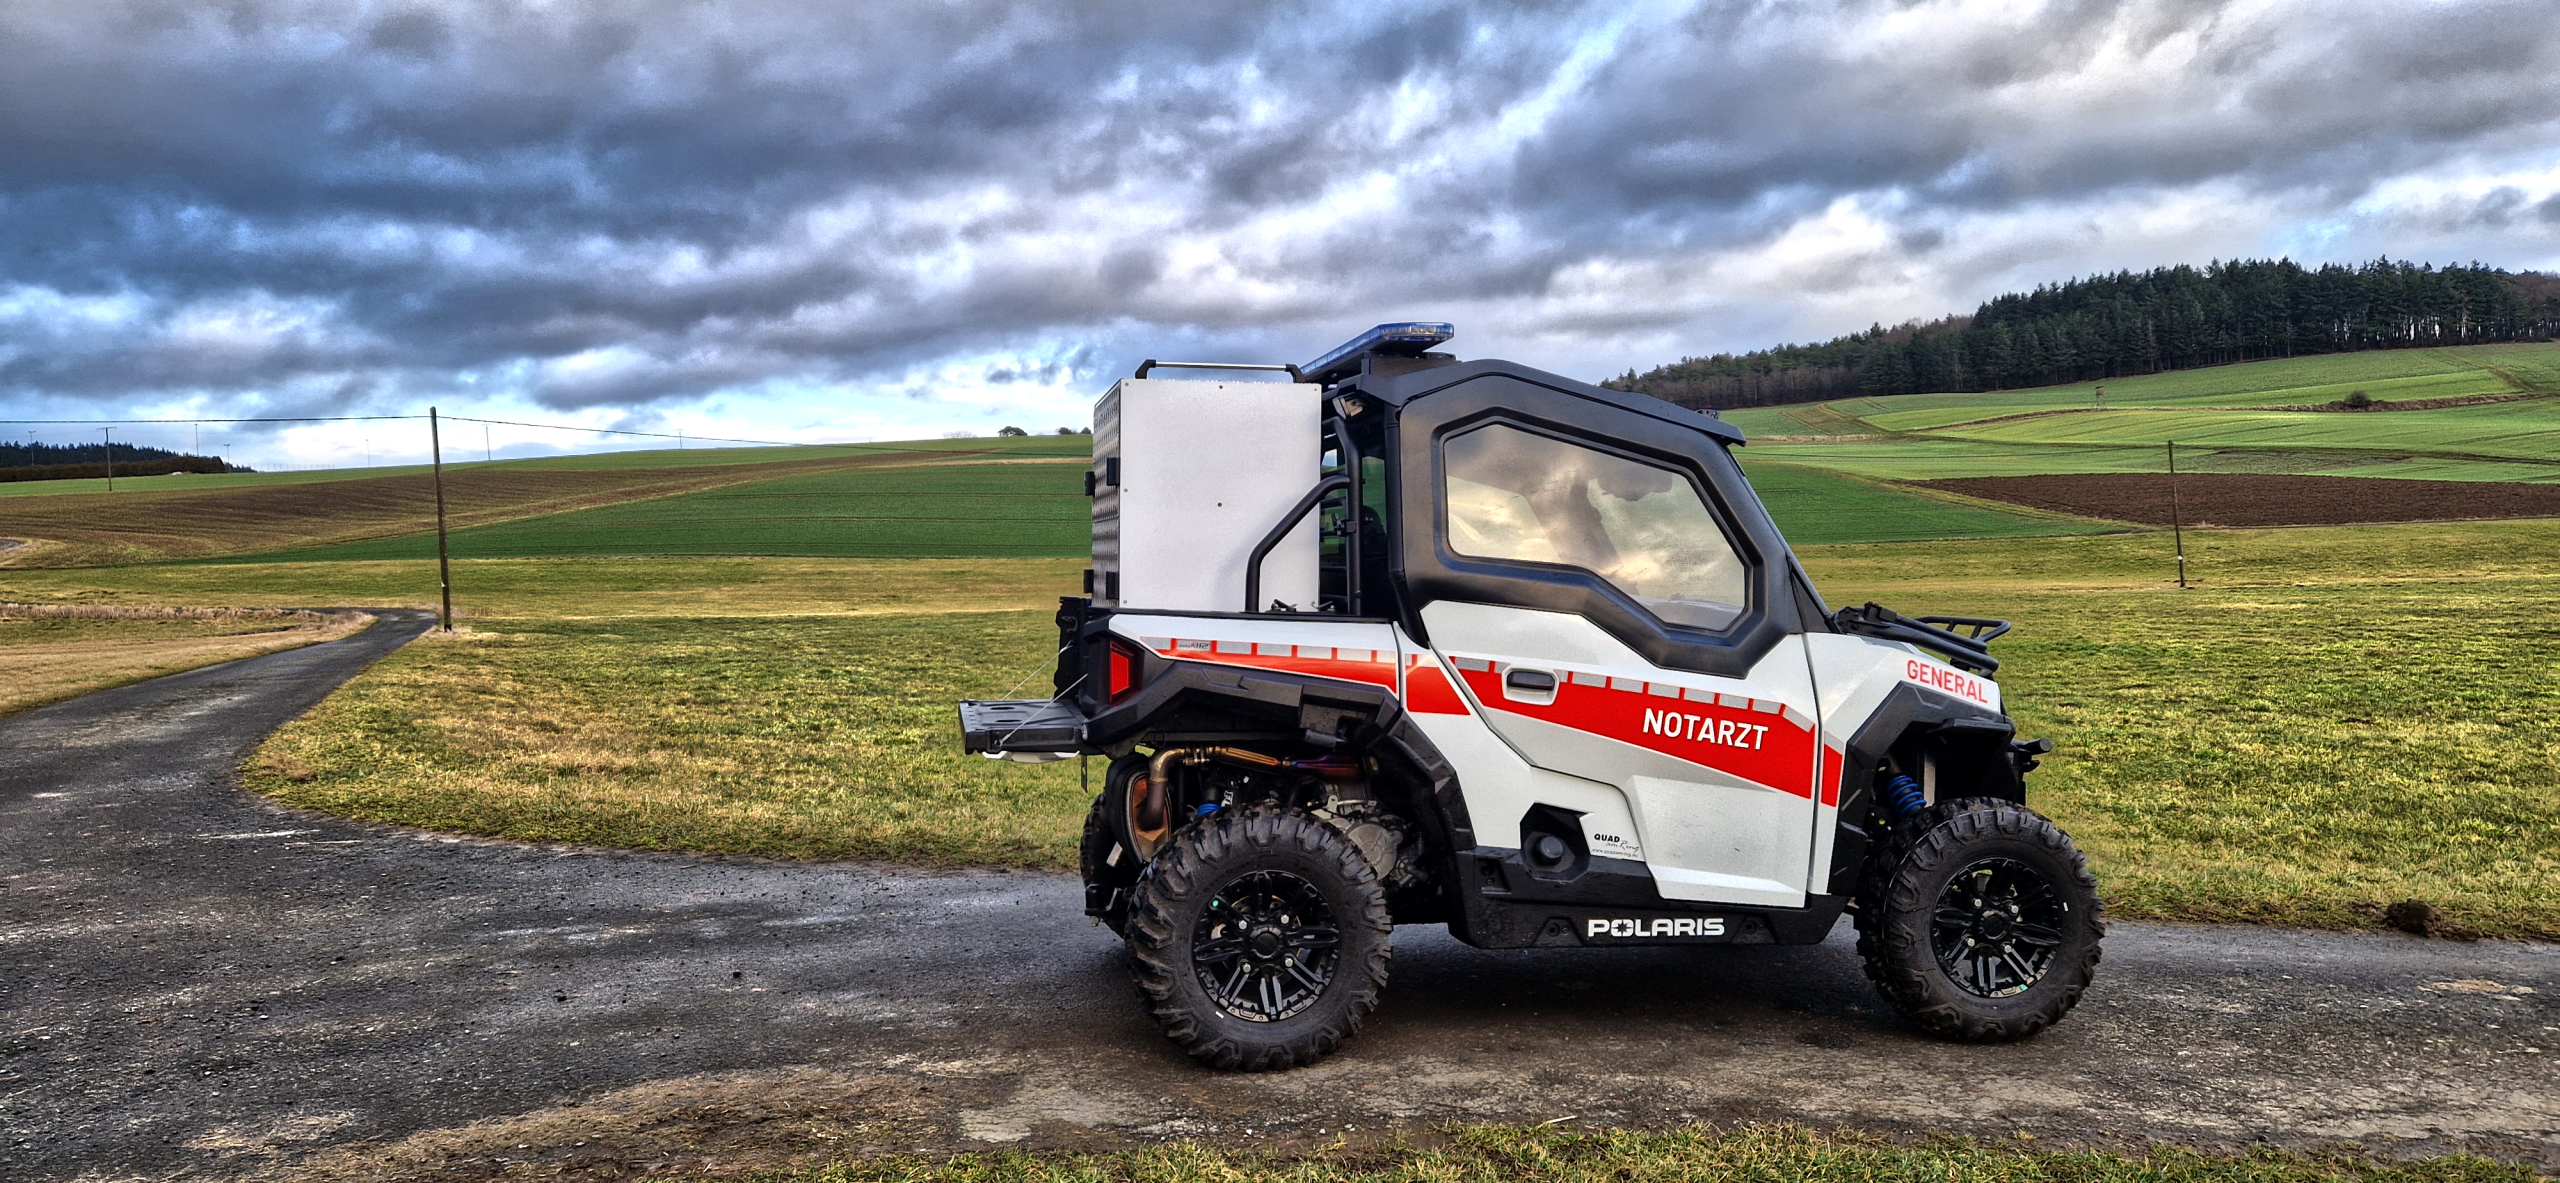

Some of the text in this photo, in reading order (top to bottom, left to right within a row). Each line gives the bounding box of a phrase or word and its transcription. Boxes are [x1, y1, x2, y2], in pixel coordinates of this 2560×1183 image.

[1907, 660, 1988, 704] GENERAL
[1642, 708, 1769, 750] NOTARZT
[1594, 833, 1620, 842] QUAD
[1588, 919, 1725, 937] POLARIS
